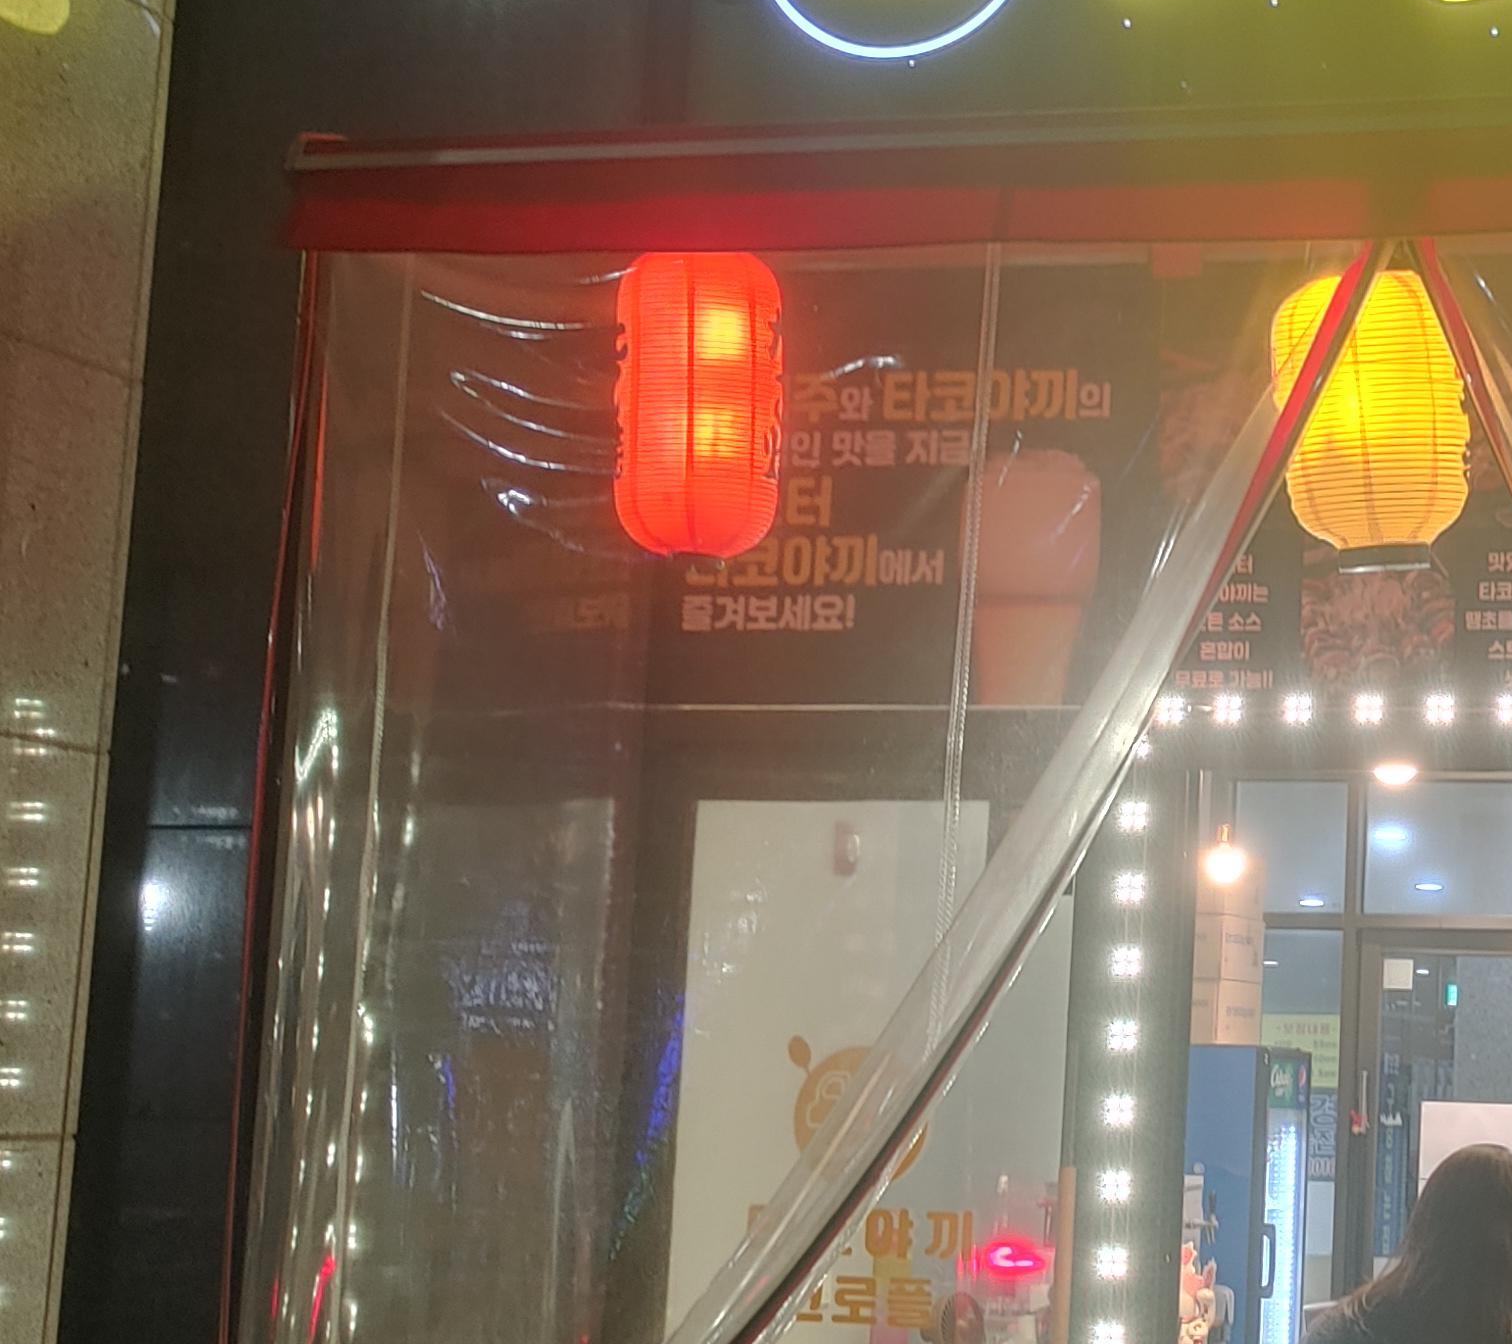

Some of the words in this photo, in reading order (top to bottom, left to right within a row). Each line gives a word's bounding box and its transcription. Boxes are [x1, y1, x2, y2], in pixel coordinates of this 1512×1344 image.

[791, 371, 872, 422] 주와
[883, 369, 1111, 421] 타코야끼의
[831, 429, 896, 466] 맛을
[905, 429, 971, 466] 지금
[785, 475, 832, 527] 터
[1217, 582, 1269, 603] 야끼는
[681, 594, 855, 632] 즐겨보세요!
[1202, 612, 1223, 632] 든
[1228, 611, 1261, 632] 소스
